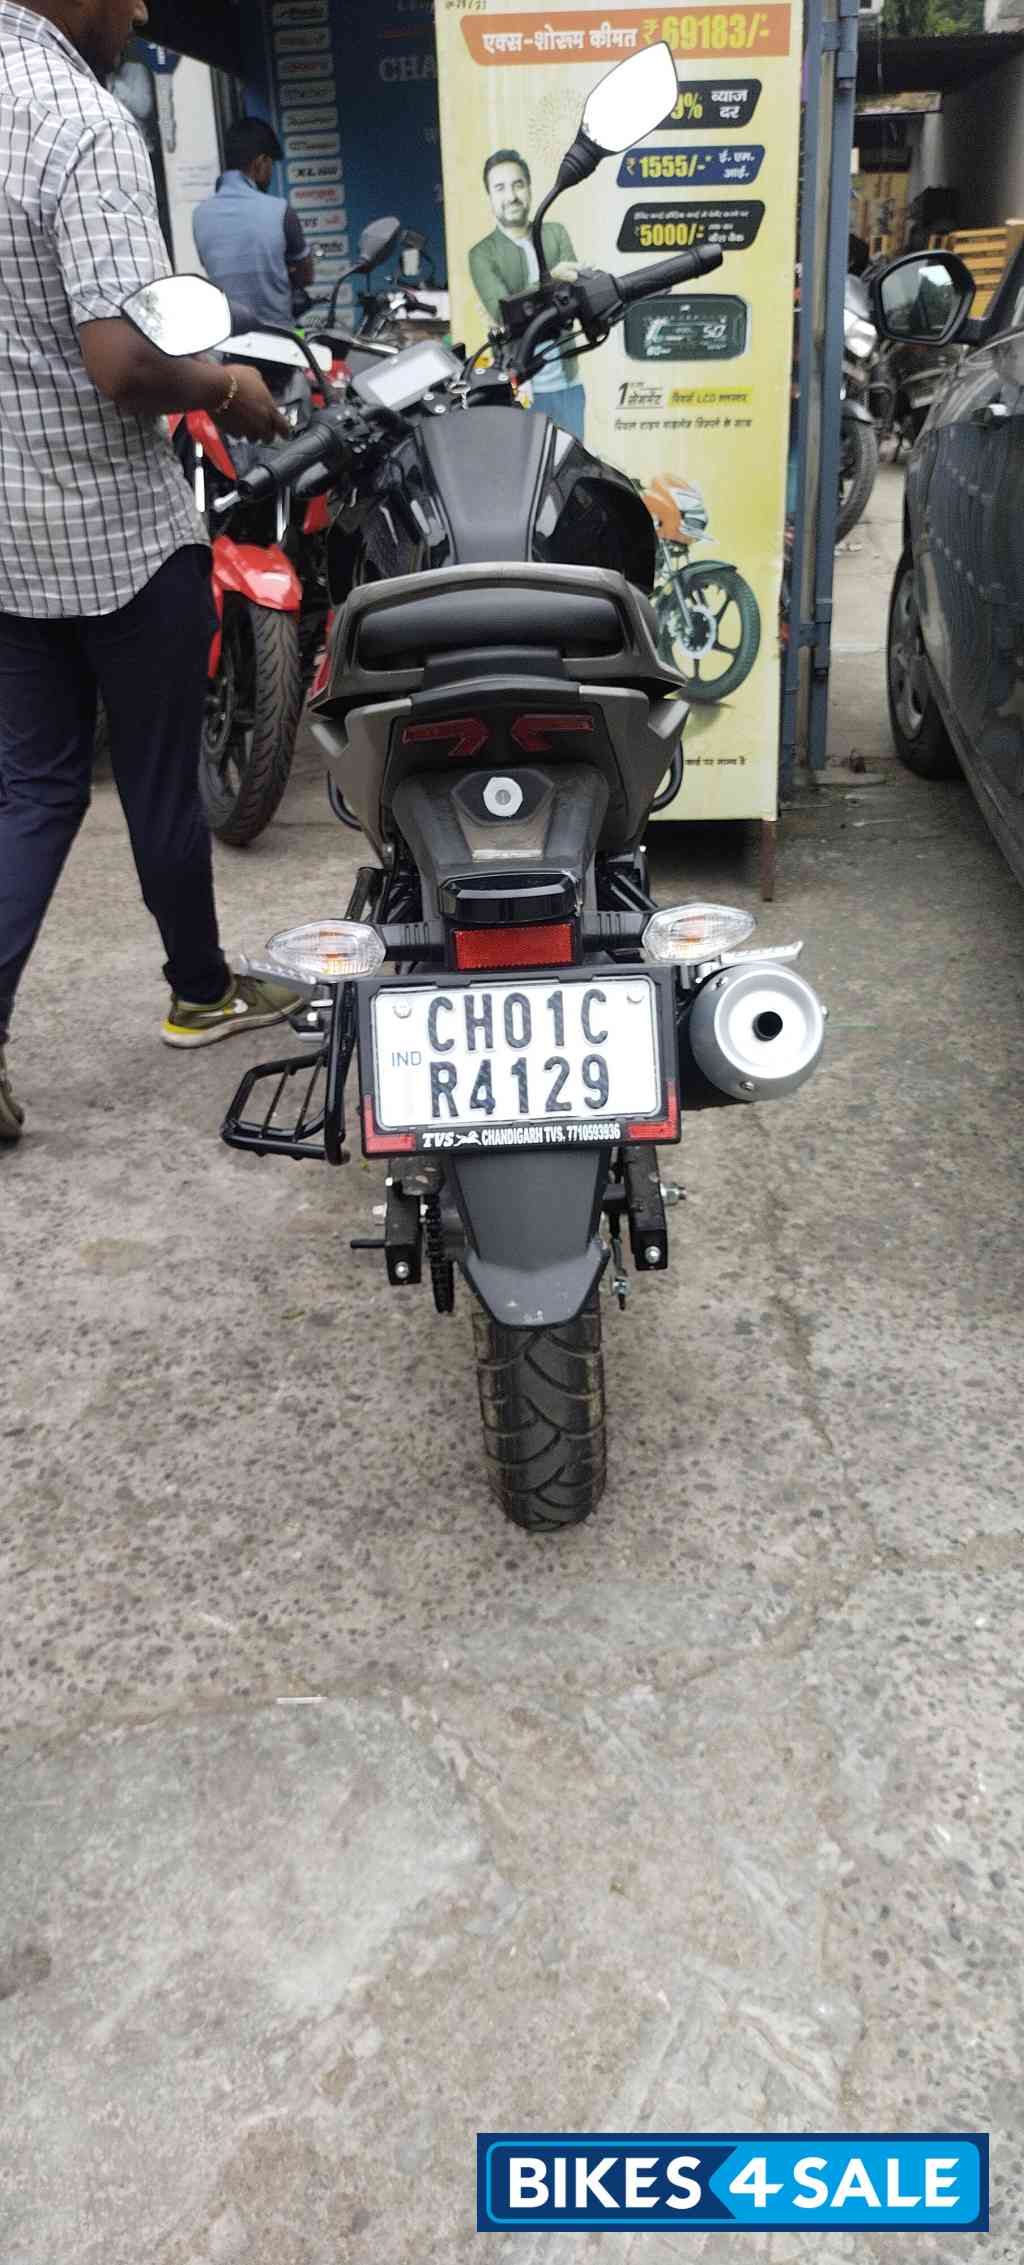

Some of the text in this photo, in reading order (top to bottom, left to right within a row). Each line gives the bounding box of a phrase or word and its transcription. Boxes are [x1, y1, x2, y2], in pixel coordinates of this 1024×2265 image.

[589, 20, 638, 48] कीमत
[711, 88, 748, 103] ब्याज
[719, 105, 741, 119] दर
[428, 988, 609, 1052] CH01C
[391, 1050, 422, 1067] IND
[429, 1053, 609, 1118] R4129
[422, 1131, 455, 1148] TVS
[481, 1128, 543, 1146] CHANDIGARH
